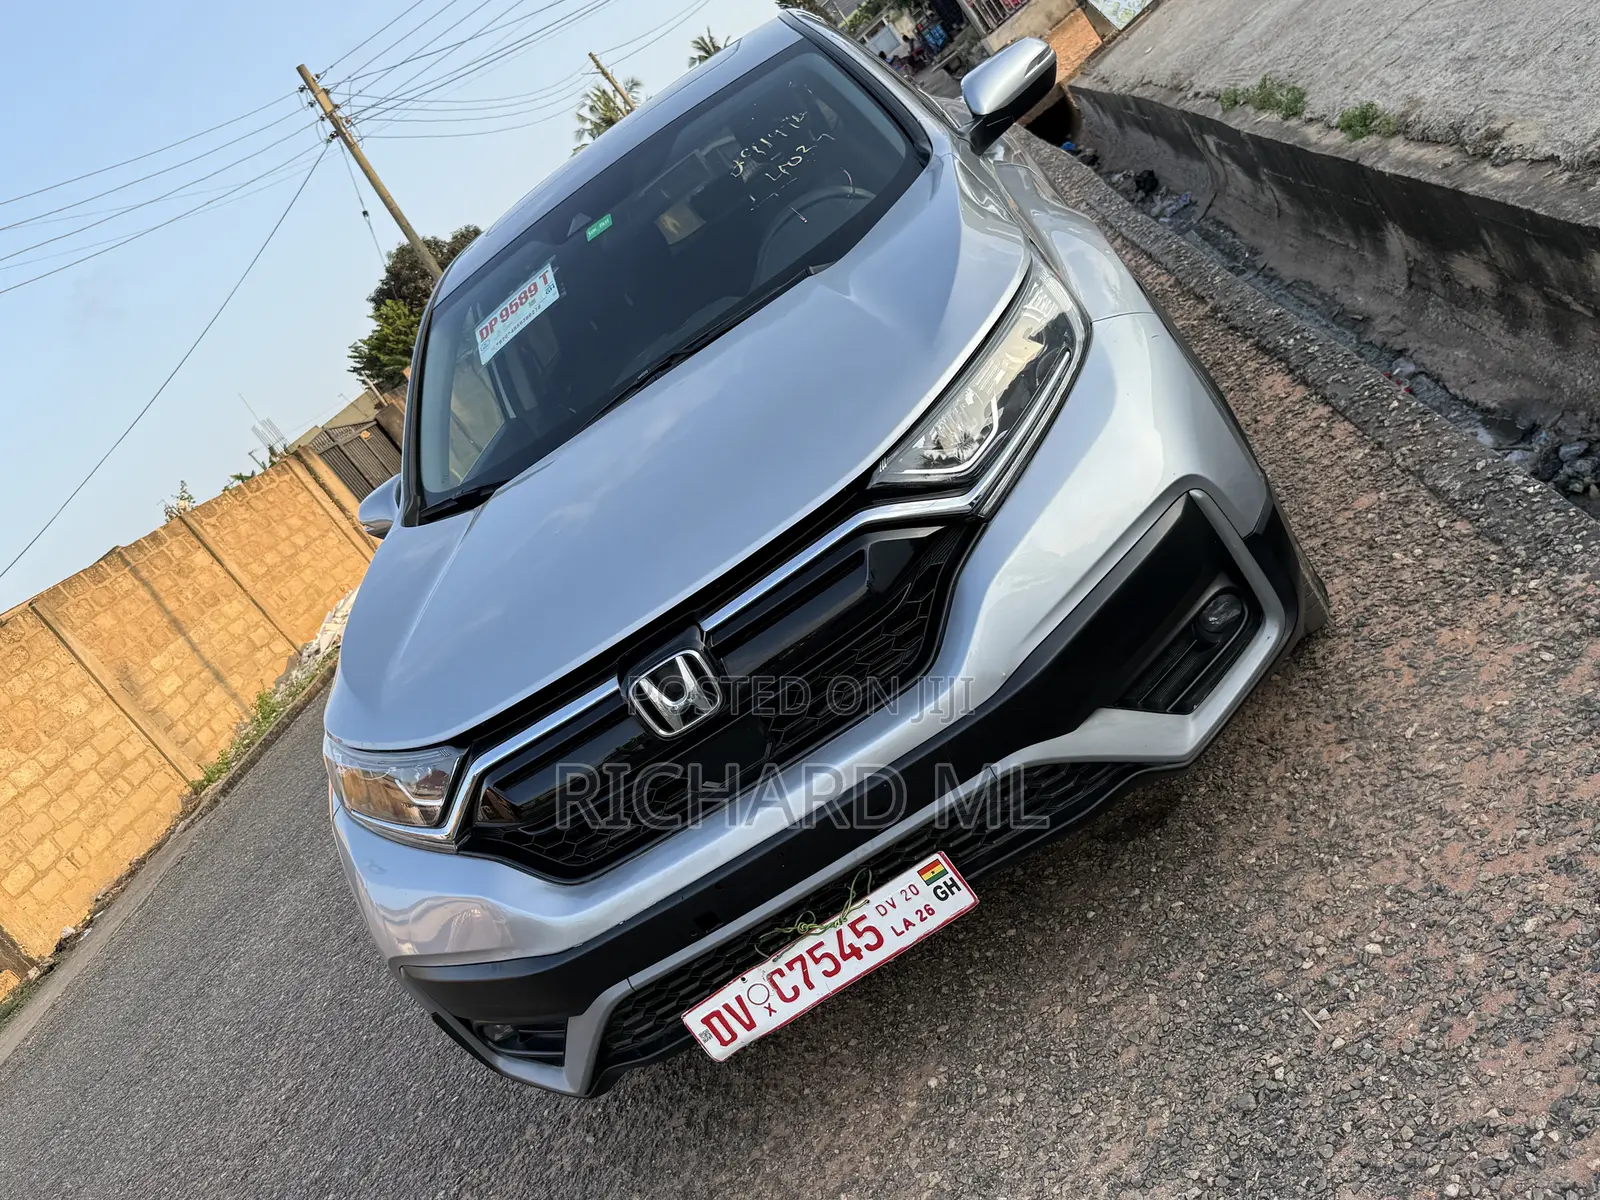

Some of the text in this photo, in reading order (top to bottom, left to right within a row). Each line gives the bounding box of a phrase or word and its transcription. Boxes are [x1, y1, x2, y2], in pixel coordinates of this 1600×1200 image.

[479, 316, 498, 342] DP
[499, 281, 539, 323] 9589
[538, 270, 549, 286] T
[875, 883, 920, 917] DV 20
[932, 876, 962, 902] GH
[890, 903, 936, 937] LA 26
[700, 994, 757, 1047] DV
[766, 914, 885, 1004] C7545
